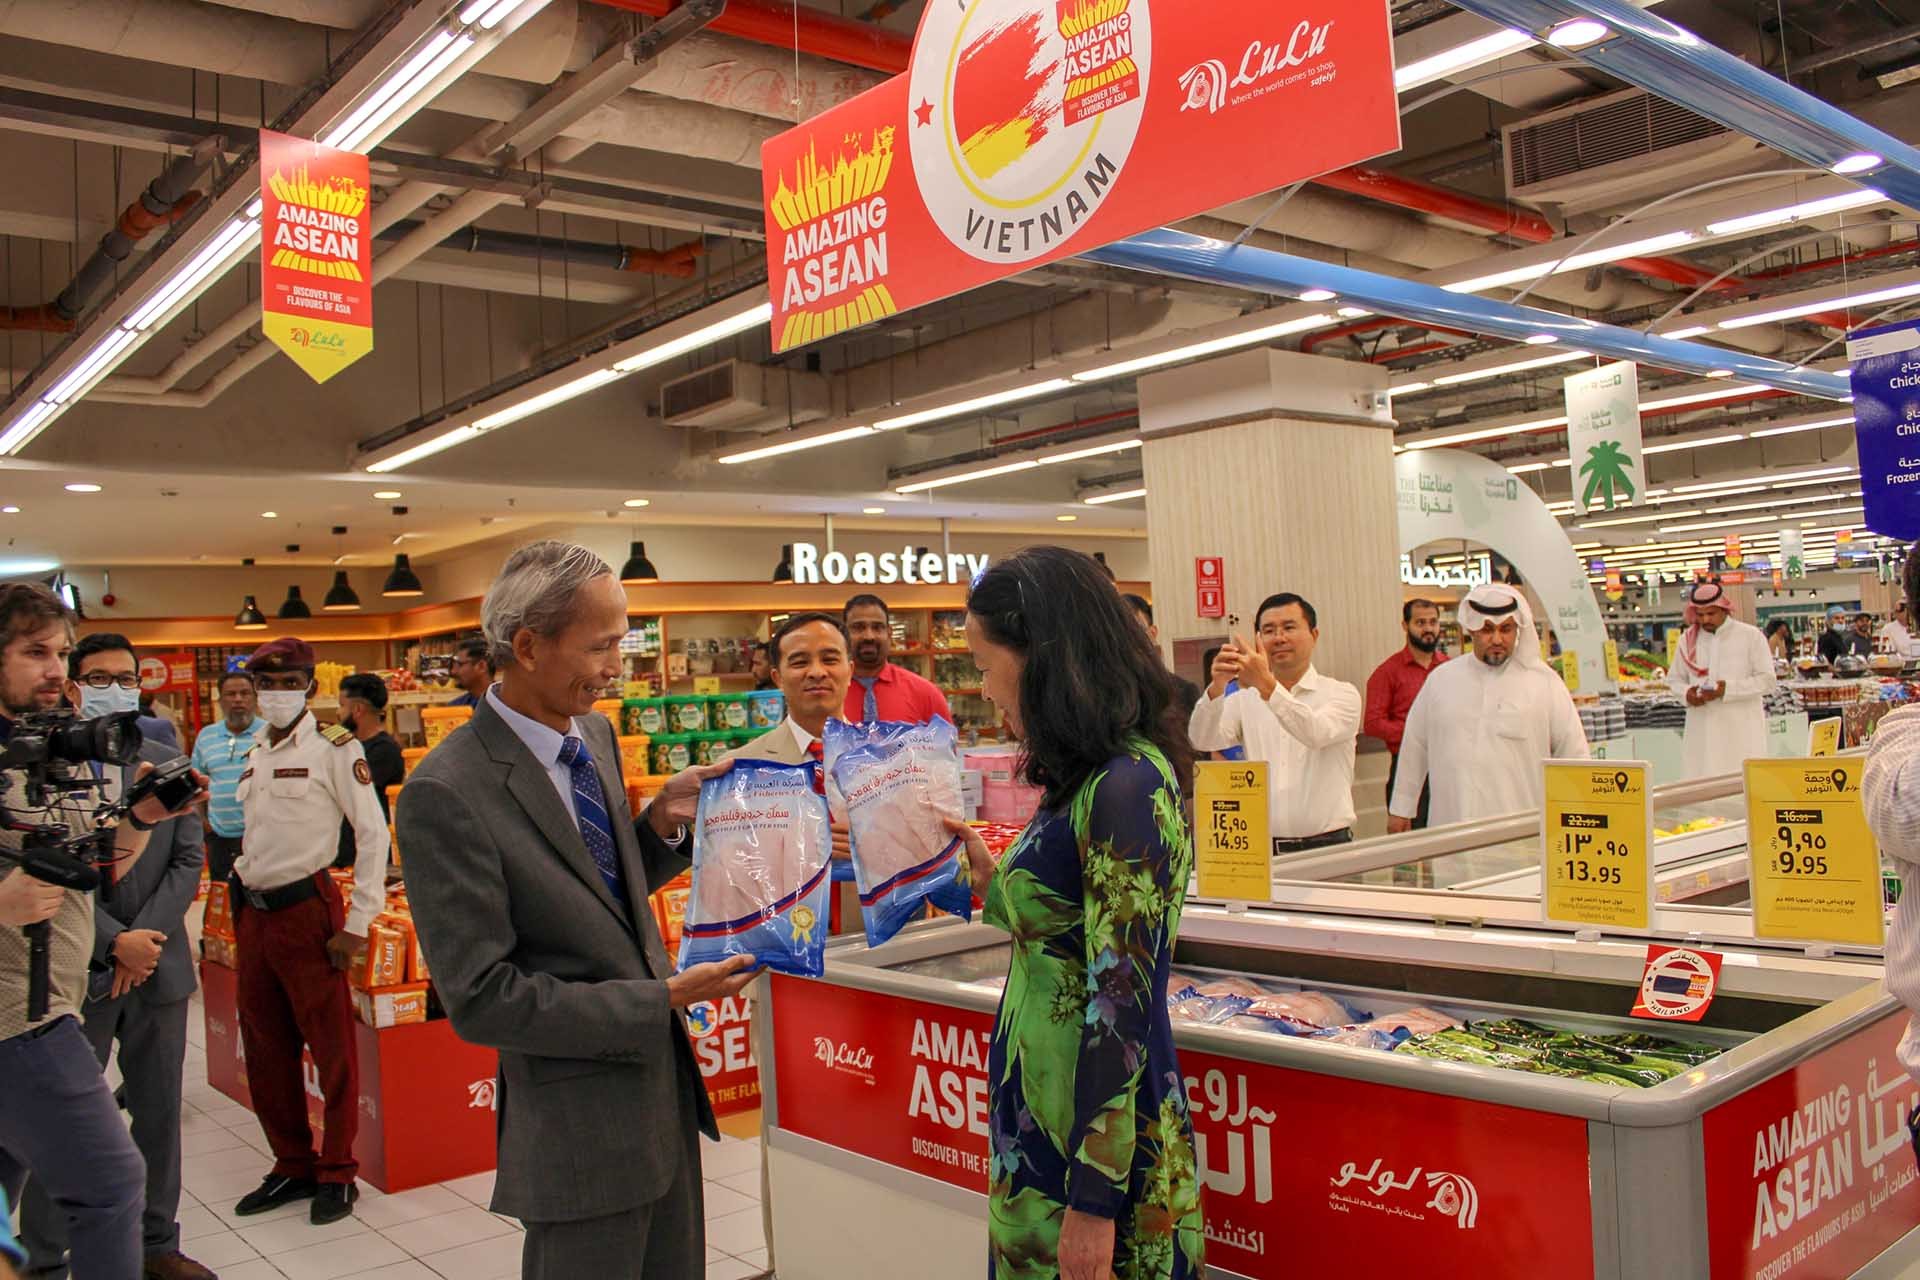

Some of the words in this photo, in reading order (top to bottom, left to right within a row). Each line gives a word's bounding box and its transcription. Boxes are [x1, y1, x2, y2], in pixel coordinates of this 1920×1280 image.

[1066, 12, 1129, 56] AMAZING
[1065, 31, 1131, 80] ASEAN
[1230, 20, 1330, 88] LuLu
[1081, 89, 1108, 106] DISCOVER
[1109, 84, 1121, 96] THE
[1231, 91, 1252, 105] Where
[1253, 87, 1264, 98] the
[1265, 79, 1284, 93] world
[1285, 72, 1307, 85] comes
[1307, 67, 1315, 77] to
[1310, 70, 1336, 88] safely!
[1078, 100, 1105, 119] FLAVOURS
[1106, 97, 1114, 107] OF
[1114, 91, 1128, 104] ASIA
[276, 203, 360, 236] AMAZING
[966, 153, 1116, 253] VIETNAM
[273, 222, 359, 261] ASEAN
[783, 196, 887, 265] AMAZING
[781, 232, 888, 312] ASEAN
[286, 295, 323, 311] FLAVOURS
[324, 301, 334, 312] OF
[334, 302, 351, 314] ASIA
[293, 285, 329, 300] DISCOVER
[329, 291, 343, 303] THE
[1400, 553, 1491, 591] المحمصة
[1213, 832, 1249, 850] 14.95
[1565, 860, 1621, 884] 13.95
[1779, 851, 1828, 875] 9.95
[835, 1042, 875, 1070] LuLu
[1753, 1083, 1851, 1178] AMAZING
[912, 1137, 959, 1167] DISCOVER
[960, 1151, 982, 1174] THE
[1330, 1158, 1423, 1197] لولو
[1752, 1130, 1854, 1250] ASEAN
[1755, 1250, 1791, 1280] DISCOVER
[1792, 1240, 1806, 1265] THE
[1807, 1216, 1841, 1255] FLAVOURS
[1841, 1208, 1850, 1231] OF
[1851, 1200, 1866, 1223] ASIA
